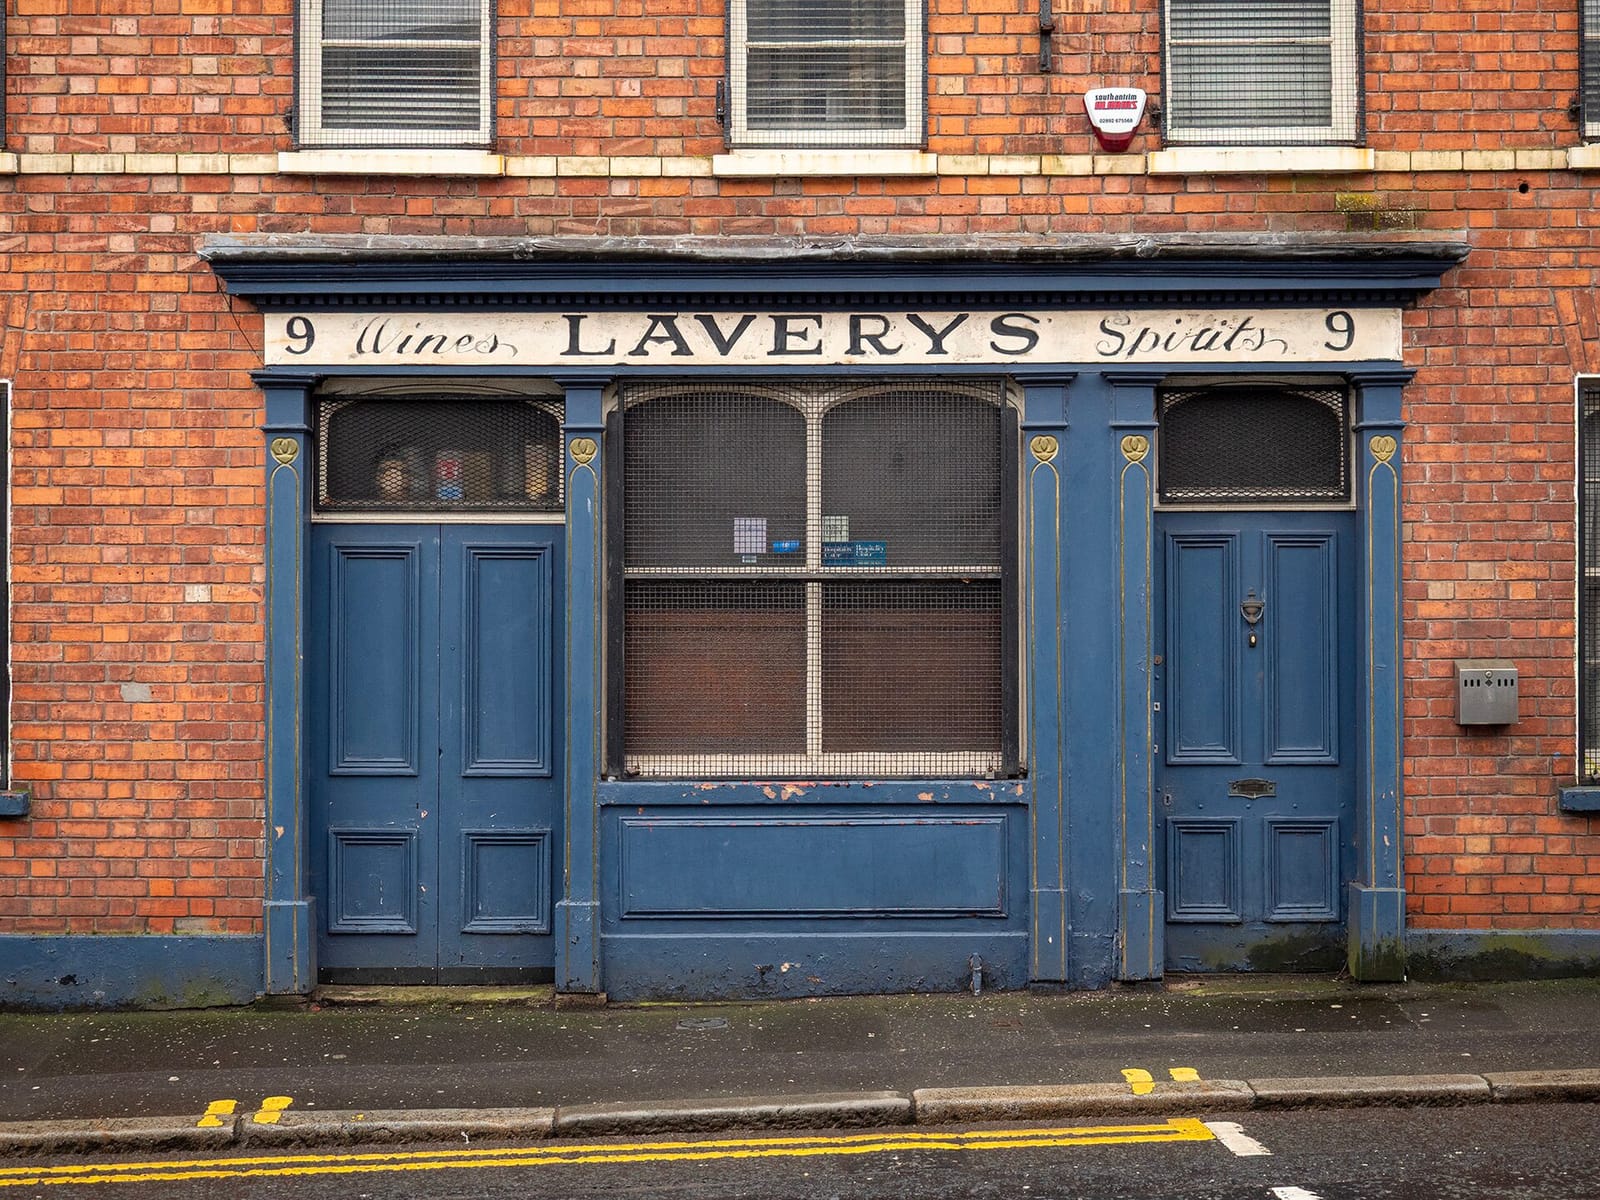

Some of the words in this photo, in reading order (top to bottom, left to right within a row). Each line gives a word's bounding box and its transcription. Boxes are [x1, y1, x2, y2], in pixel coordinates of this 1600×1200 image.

[285, 316, 315, 354] 9
[356, 315, 518, 357] Wines
[1096, 314, 1288, 360] Spirits
[1325, 310, 1355, 351] 9
